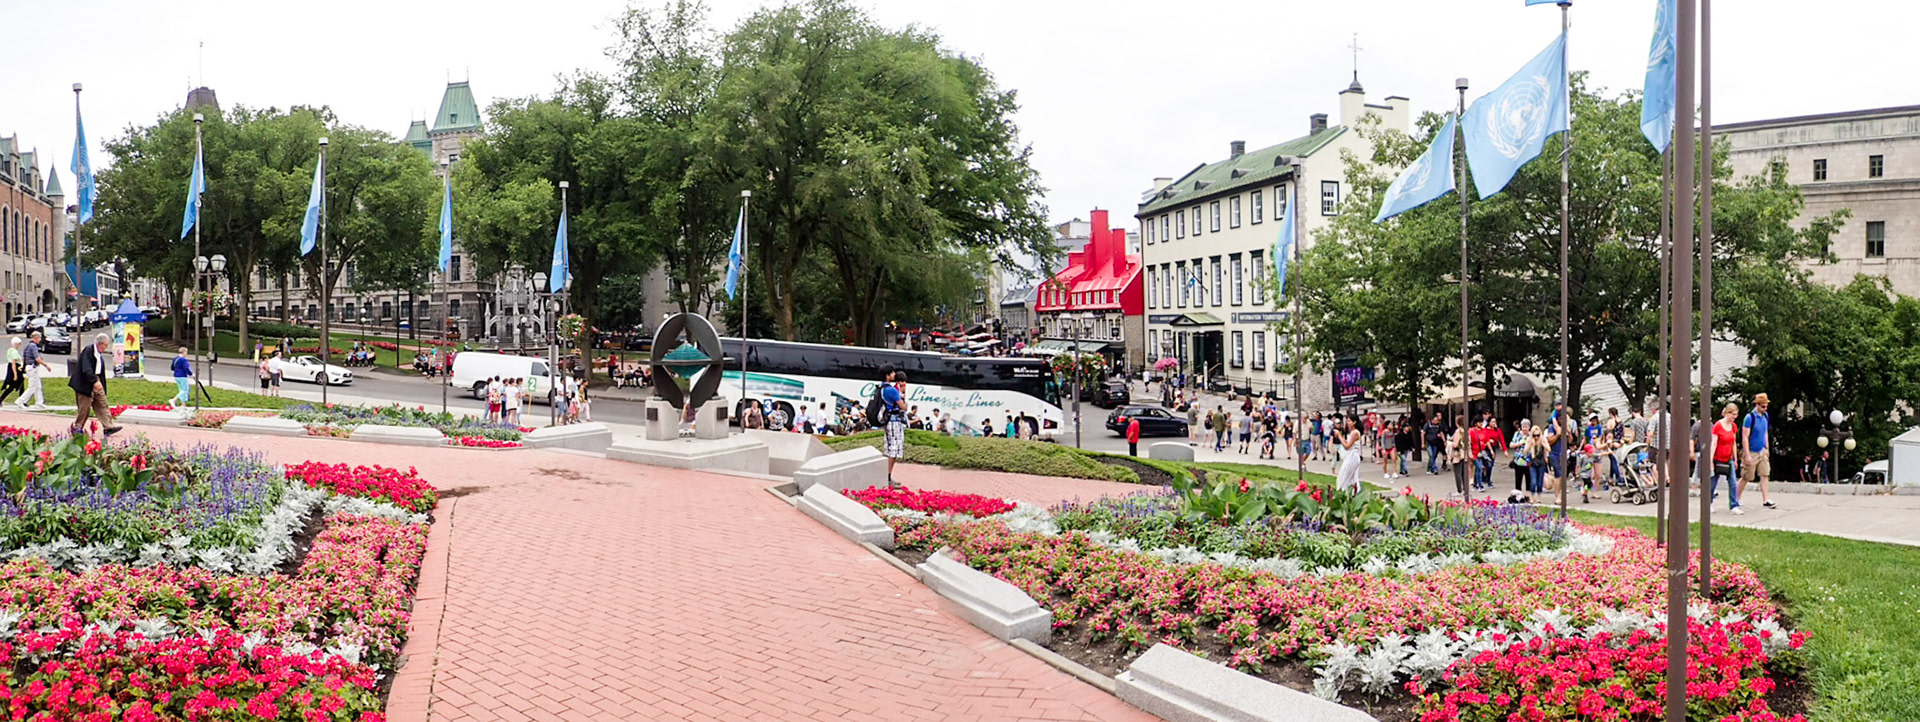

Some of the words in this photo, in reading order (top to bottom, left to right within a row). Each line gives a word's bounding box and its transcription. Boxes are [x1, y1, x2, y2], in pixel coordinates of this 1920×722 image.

[529, 378, 537, 389] 2
[966, 391, 1005, 407] Lines
[764, 400, 772, 412] 3
